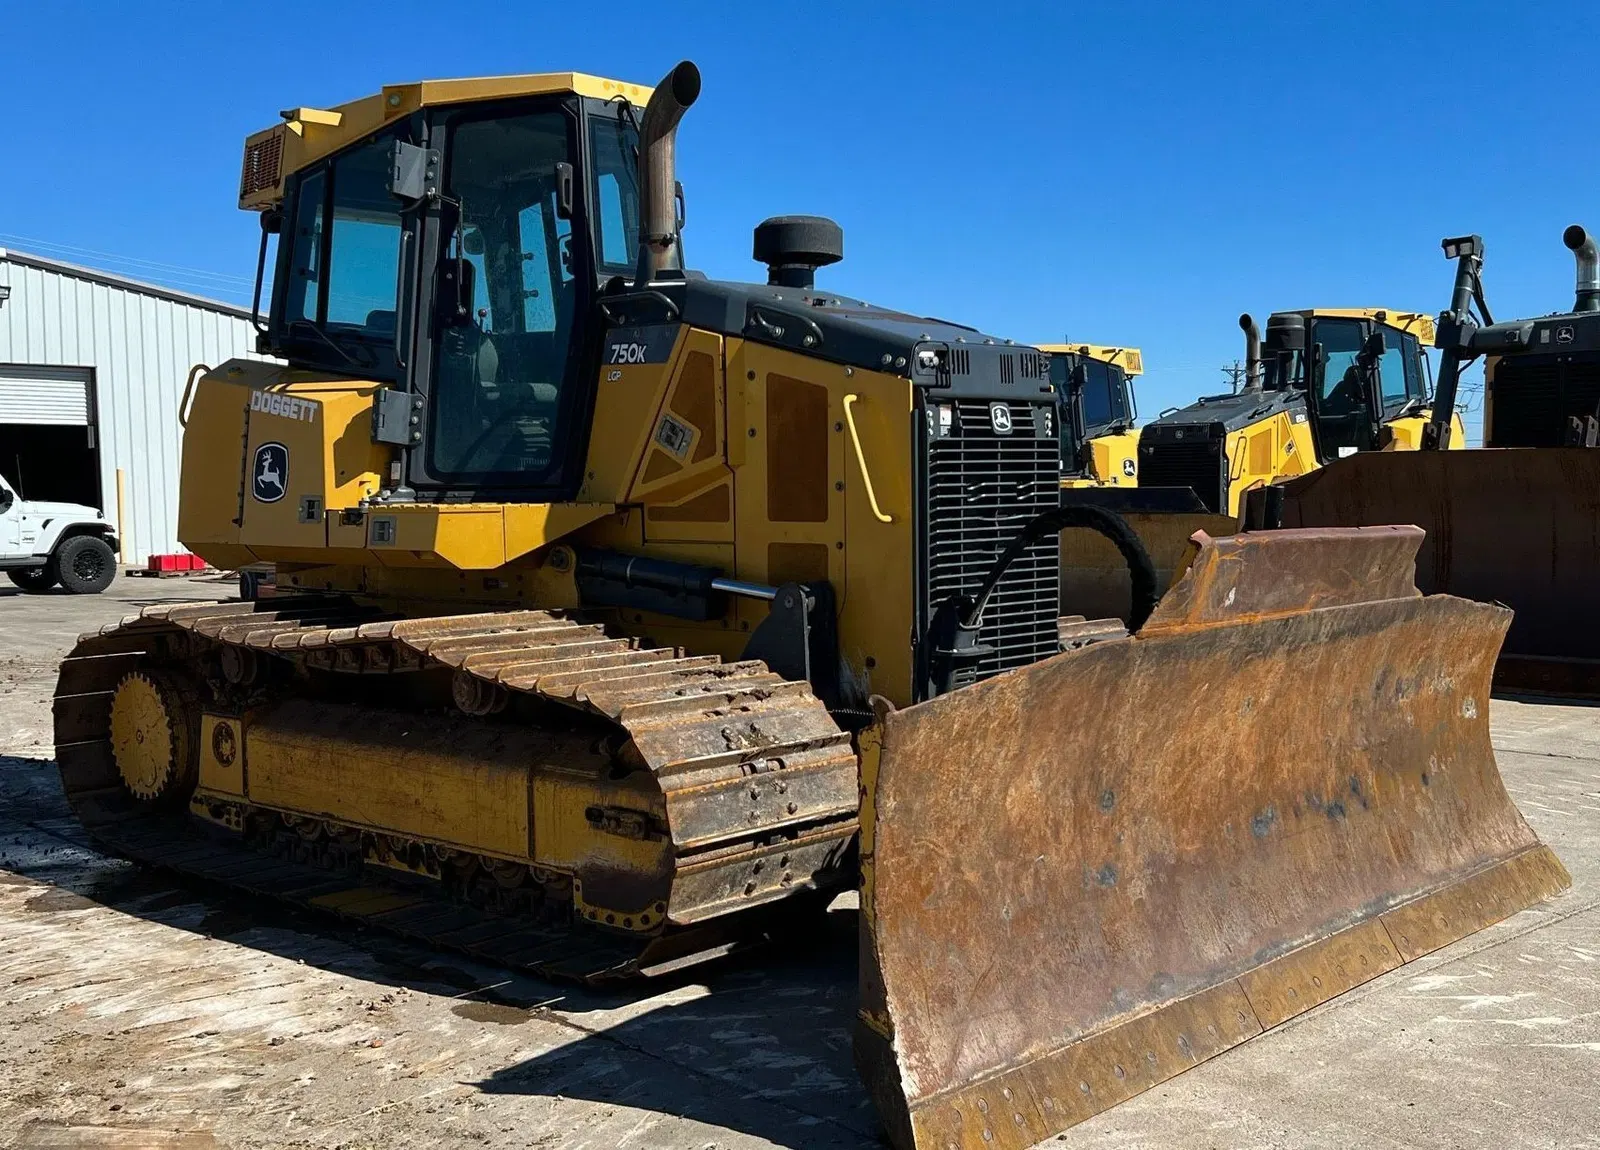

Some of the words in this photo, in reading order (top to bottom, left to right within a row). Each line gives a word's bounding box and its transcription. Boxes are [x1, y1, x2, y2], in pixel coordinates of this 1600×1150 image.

[610, 343, 647, 363] 750K
[607, 371, 622, 382] LGP
[250, 390, 318, 423] DOGGETT
